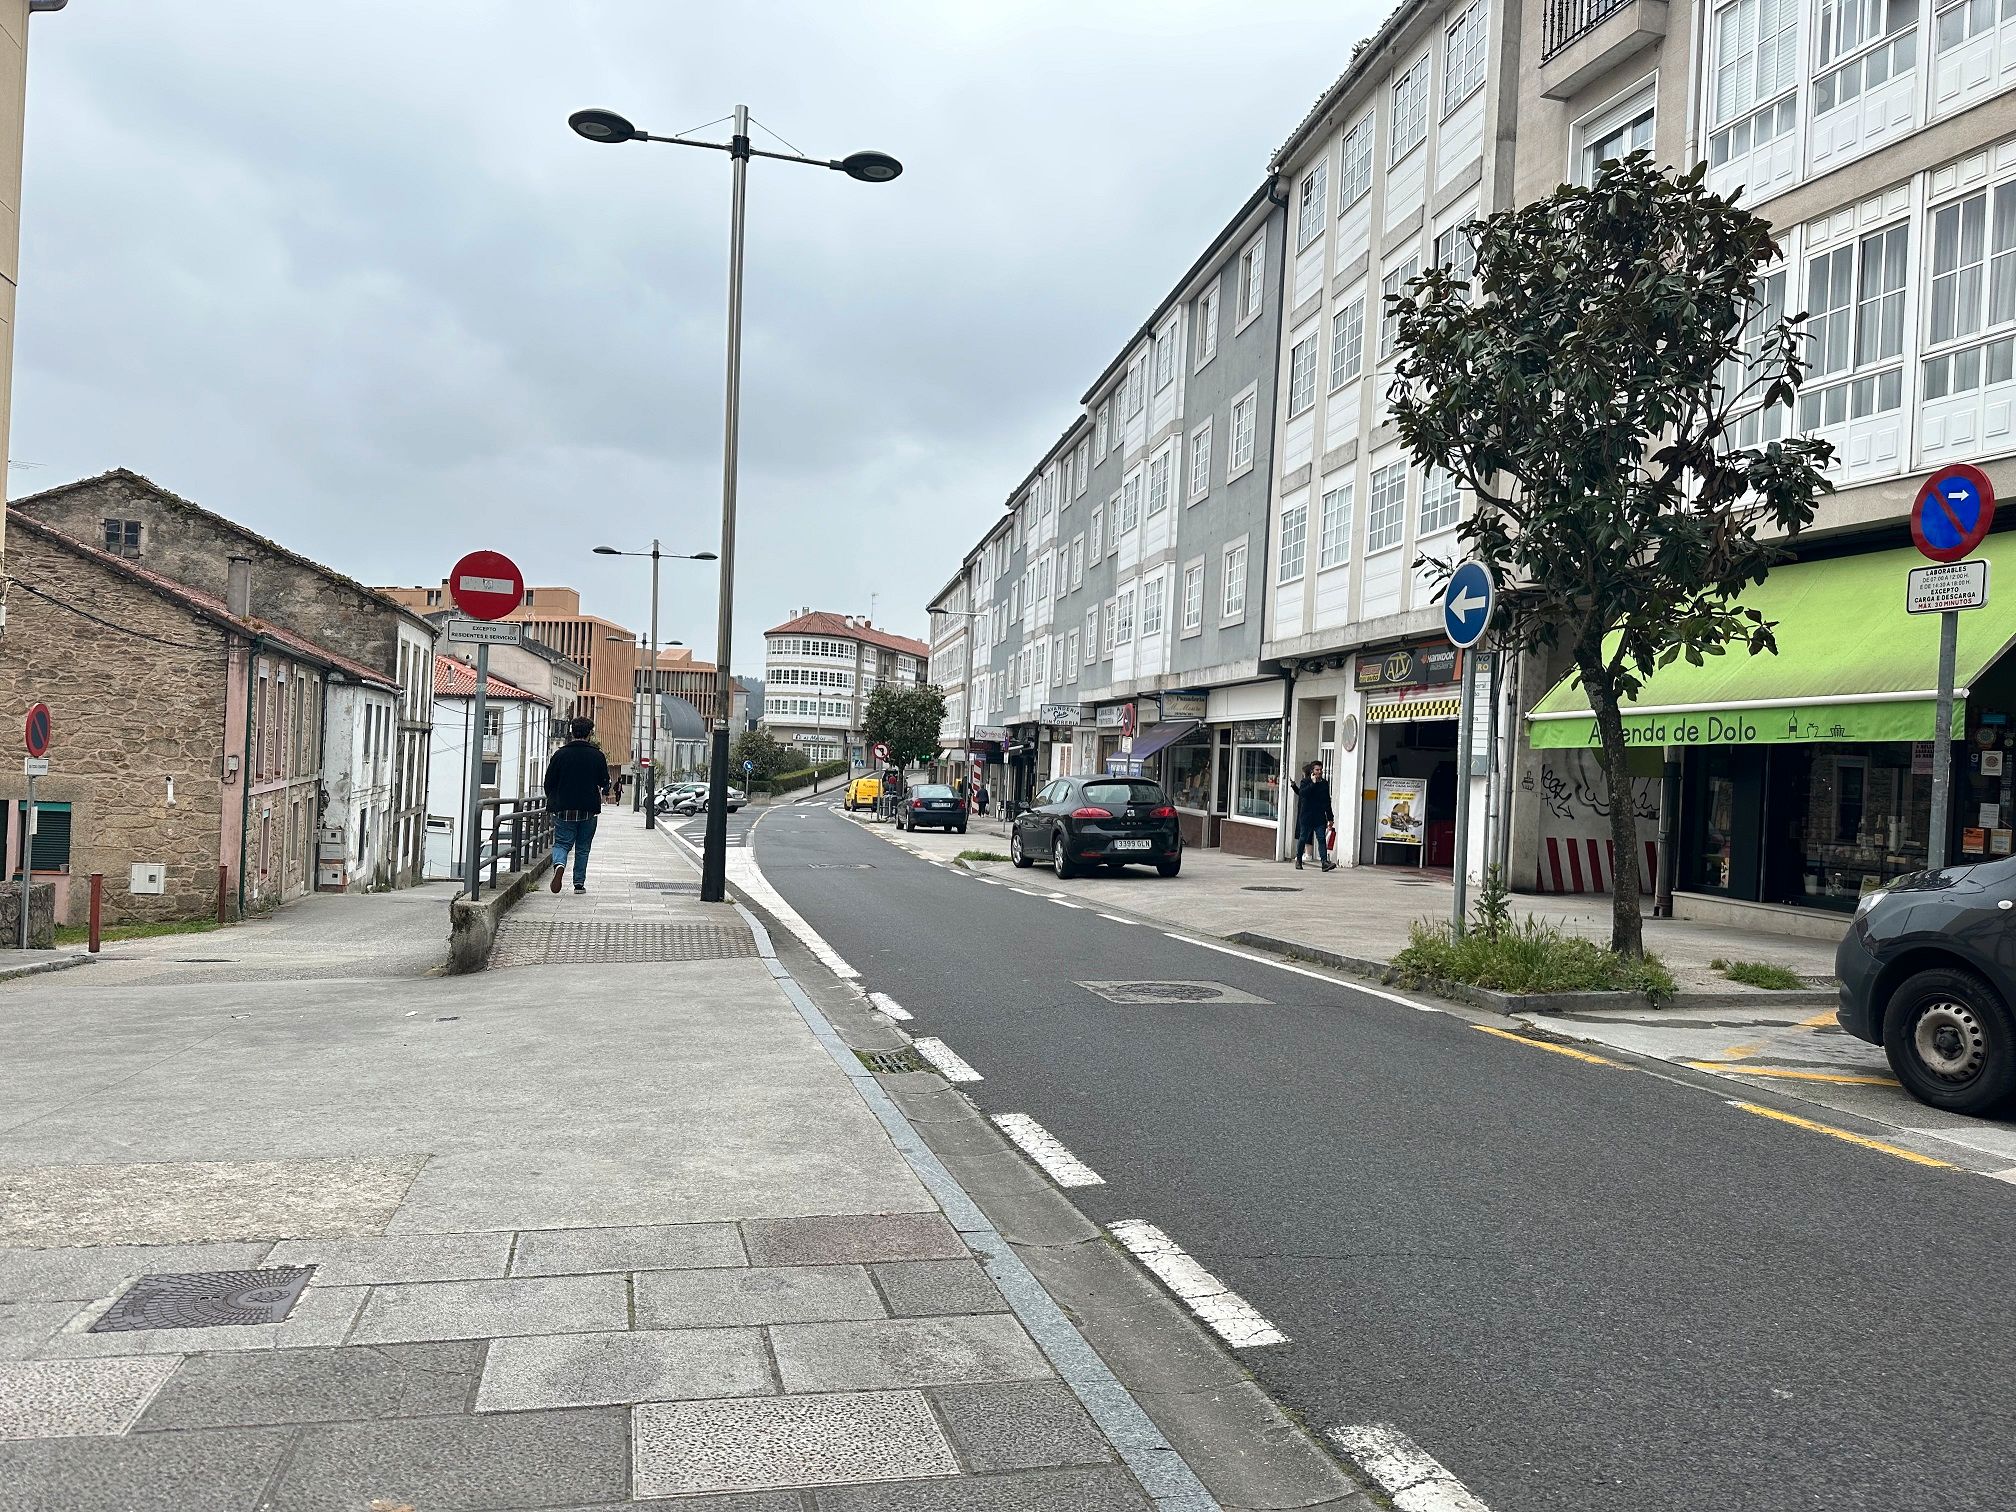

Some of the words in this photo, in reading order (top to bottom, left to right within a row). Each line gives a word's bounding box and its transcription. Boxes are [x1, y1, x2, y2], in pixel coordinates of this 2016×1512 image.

[1925, 566, 1967, 576] LABORABLES
[1930, 587, 1959, 595] EXCEPTO
[1941, 592, 1976, 600] DESCARGA
[1943, 598, 1972, 606] MINUTOS
[1673, 718, 1699, 743] de
[1708, 716, 1757, 742] Dolo
